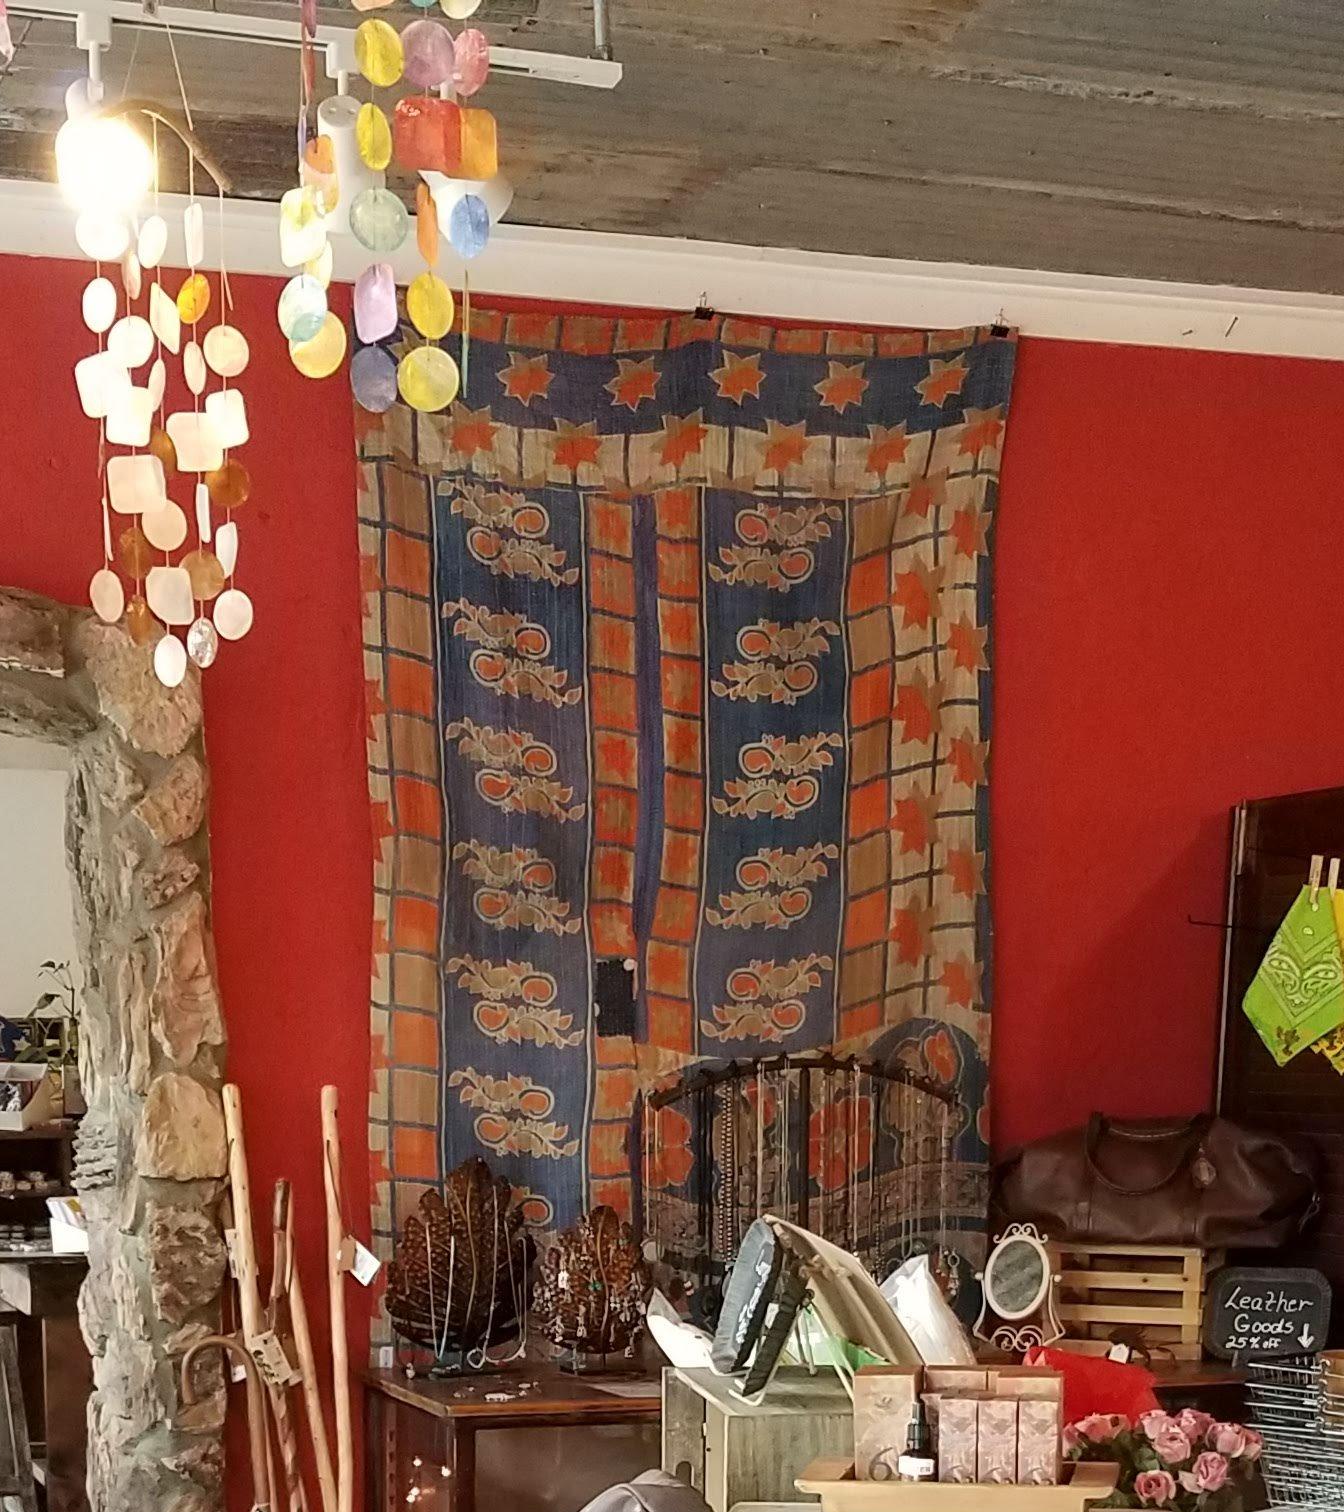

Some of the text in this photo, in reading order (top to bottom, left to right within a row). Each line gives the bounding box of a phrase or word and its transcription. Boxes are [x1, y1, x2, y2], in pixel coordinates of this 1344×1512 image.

[1225, 1286, 1314, 1313] Leather
[1233, 1313, 1295, 1334] Goods
[1225, 1335, 1260, 1349] 25%
